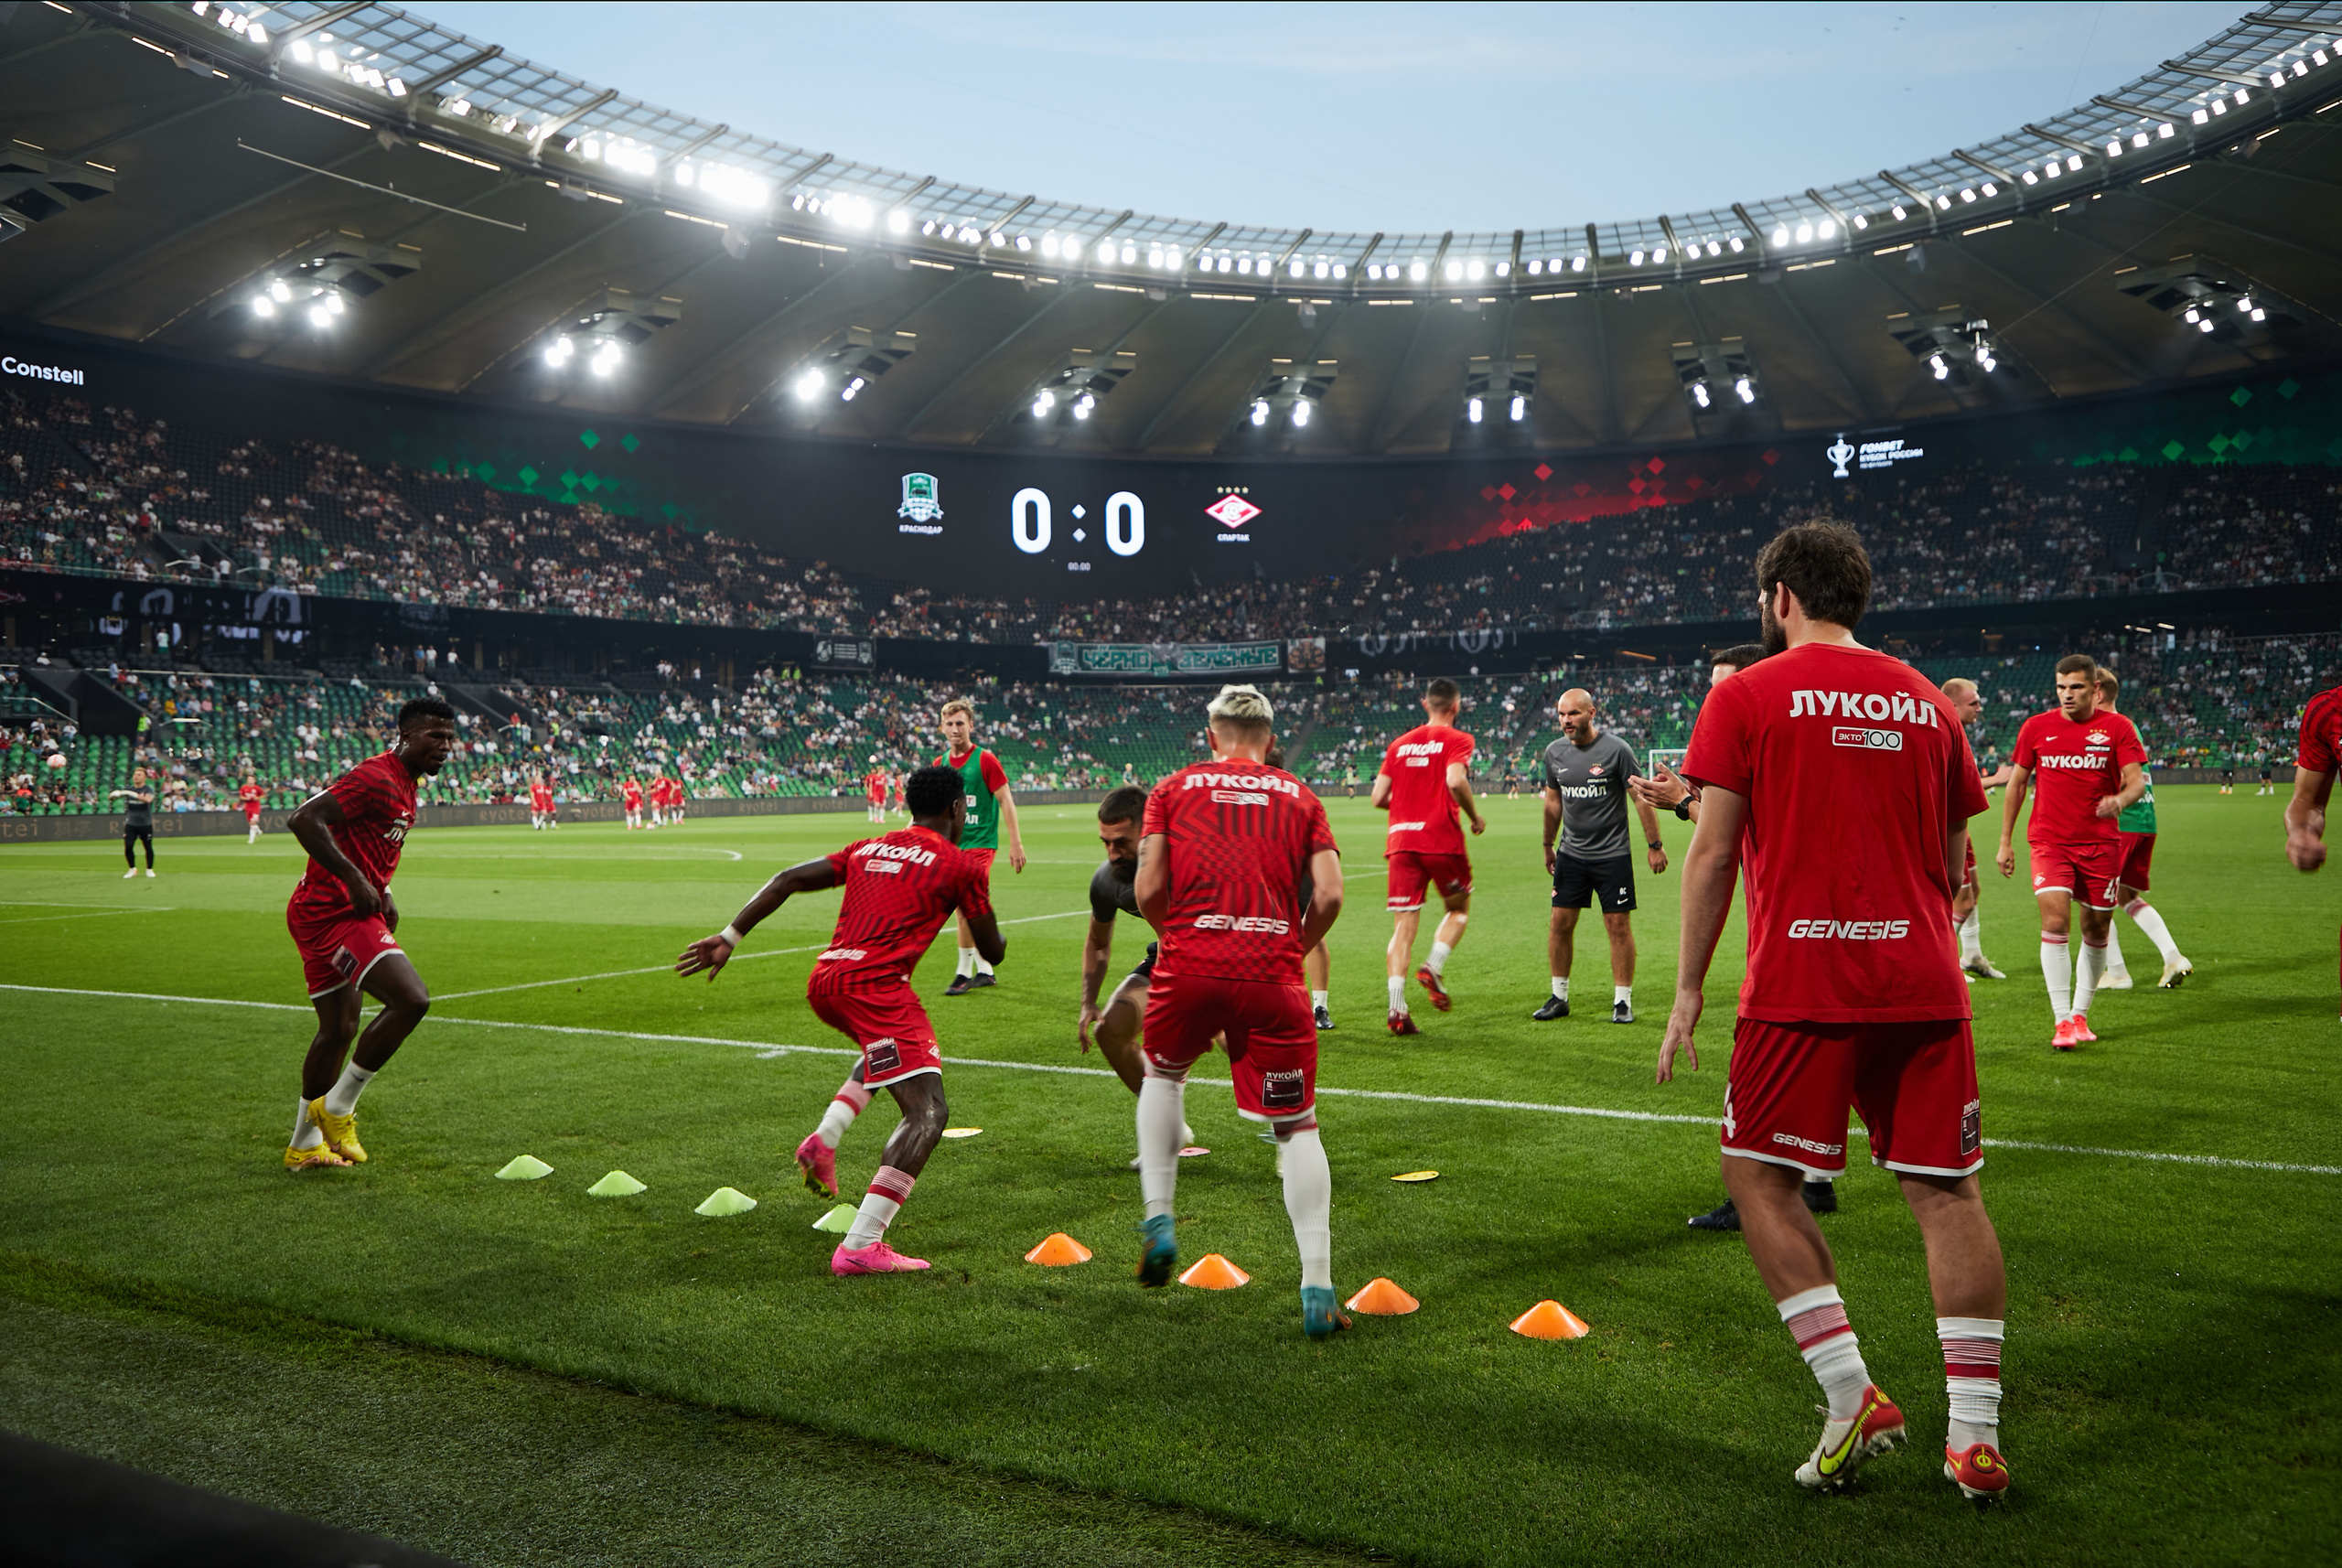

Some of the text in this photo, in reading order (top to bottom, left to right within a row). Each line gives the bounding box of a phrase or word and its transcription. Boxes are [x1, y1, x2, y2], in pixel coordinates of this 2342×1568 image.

[1, 356, 84, 386] Constell
[1012, 487, 1051, 554] 0
[1105, 490, 1144, 556] 0
[1217, 532, 1251, 542] СПАРТАК
[1789, 690, 1939, 729] ЛУКОЙЛ
[1396, 739, 1445, 758] ЛУКОЙЛ
[2041, 753, 2108, 769] ЛУКОЙЛ
[1181, 773, 1300, 799] ЛУКОЙЛ
[854, 843, 938, 866] ЛУКОЙЛ
[1193, 914, 1290, 935] GENESIS
[1788, 918, 1910, 940] GENESIS
[1265, 1068, 1304, 1079] ЛУКОЙЛ
[1772, 1133, 1842, 1155] GENESIS
